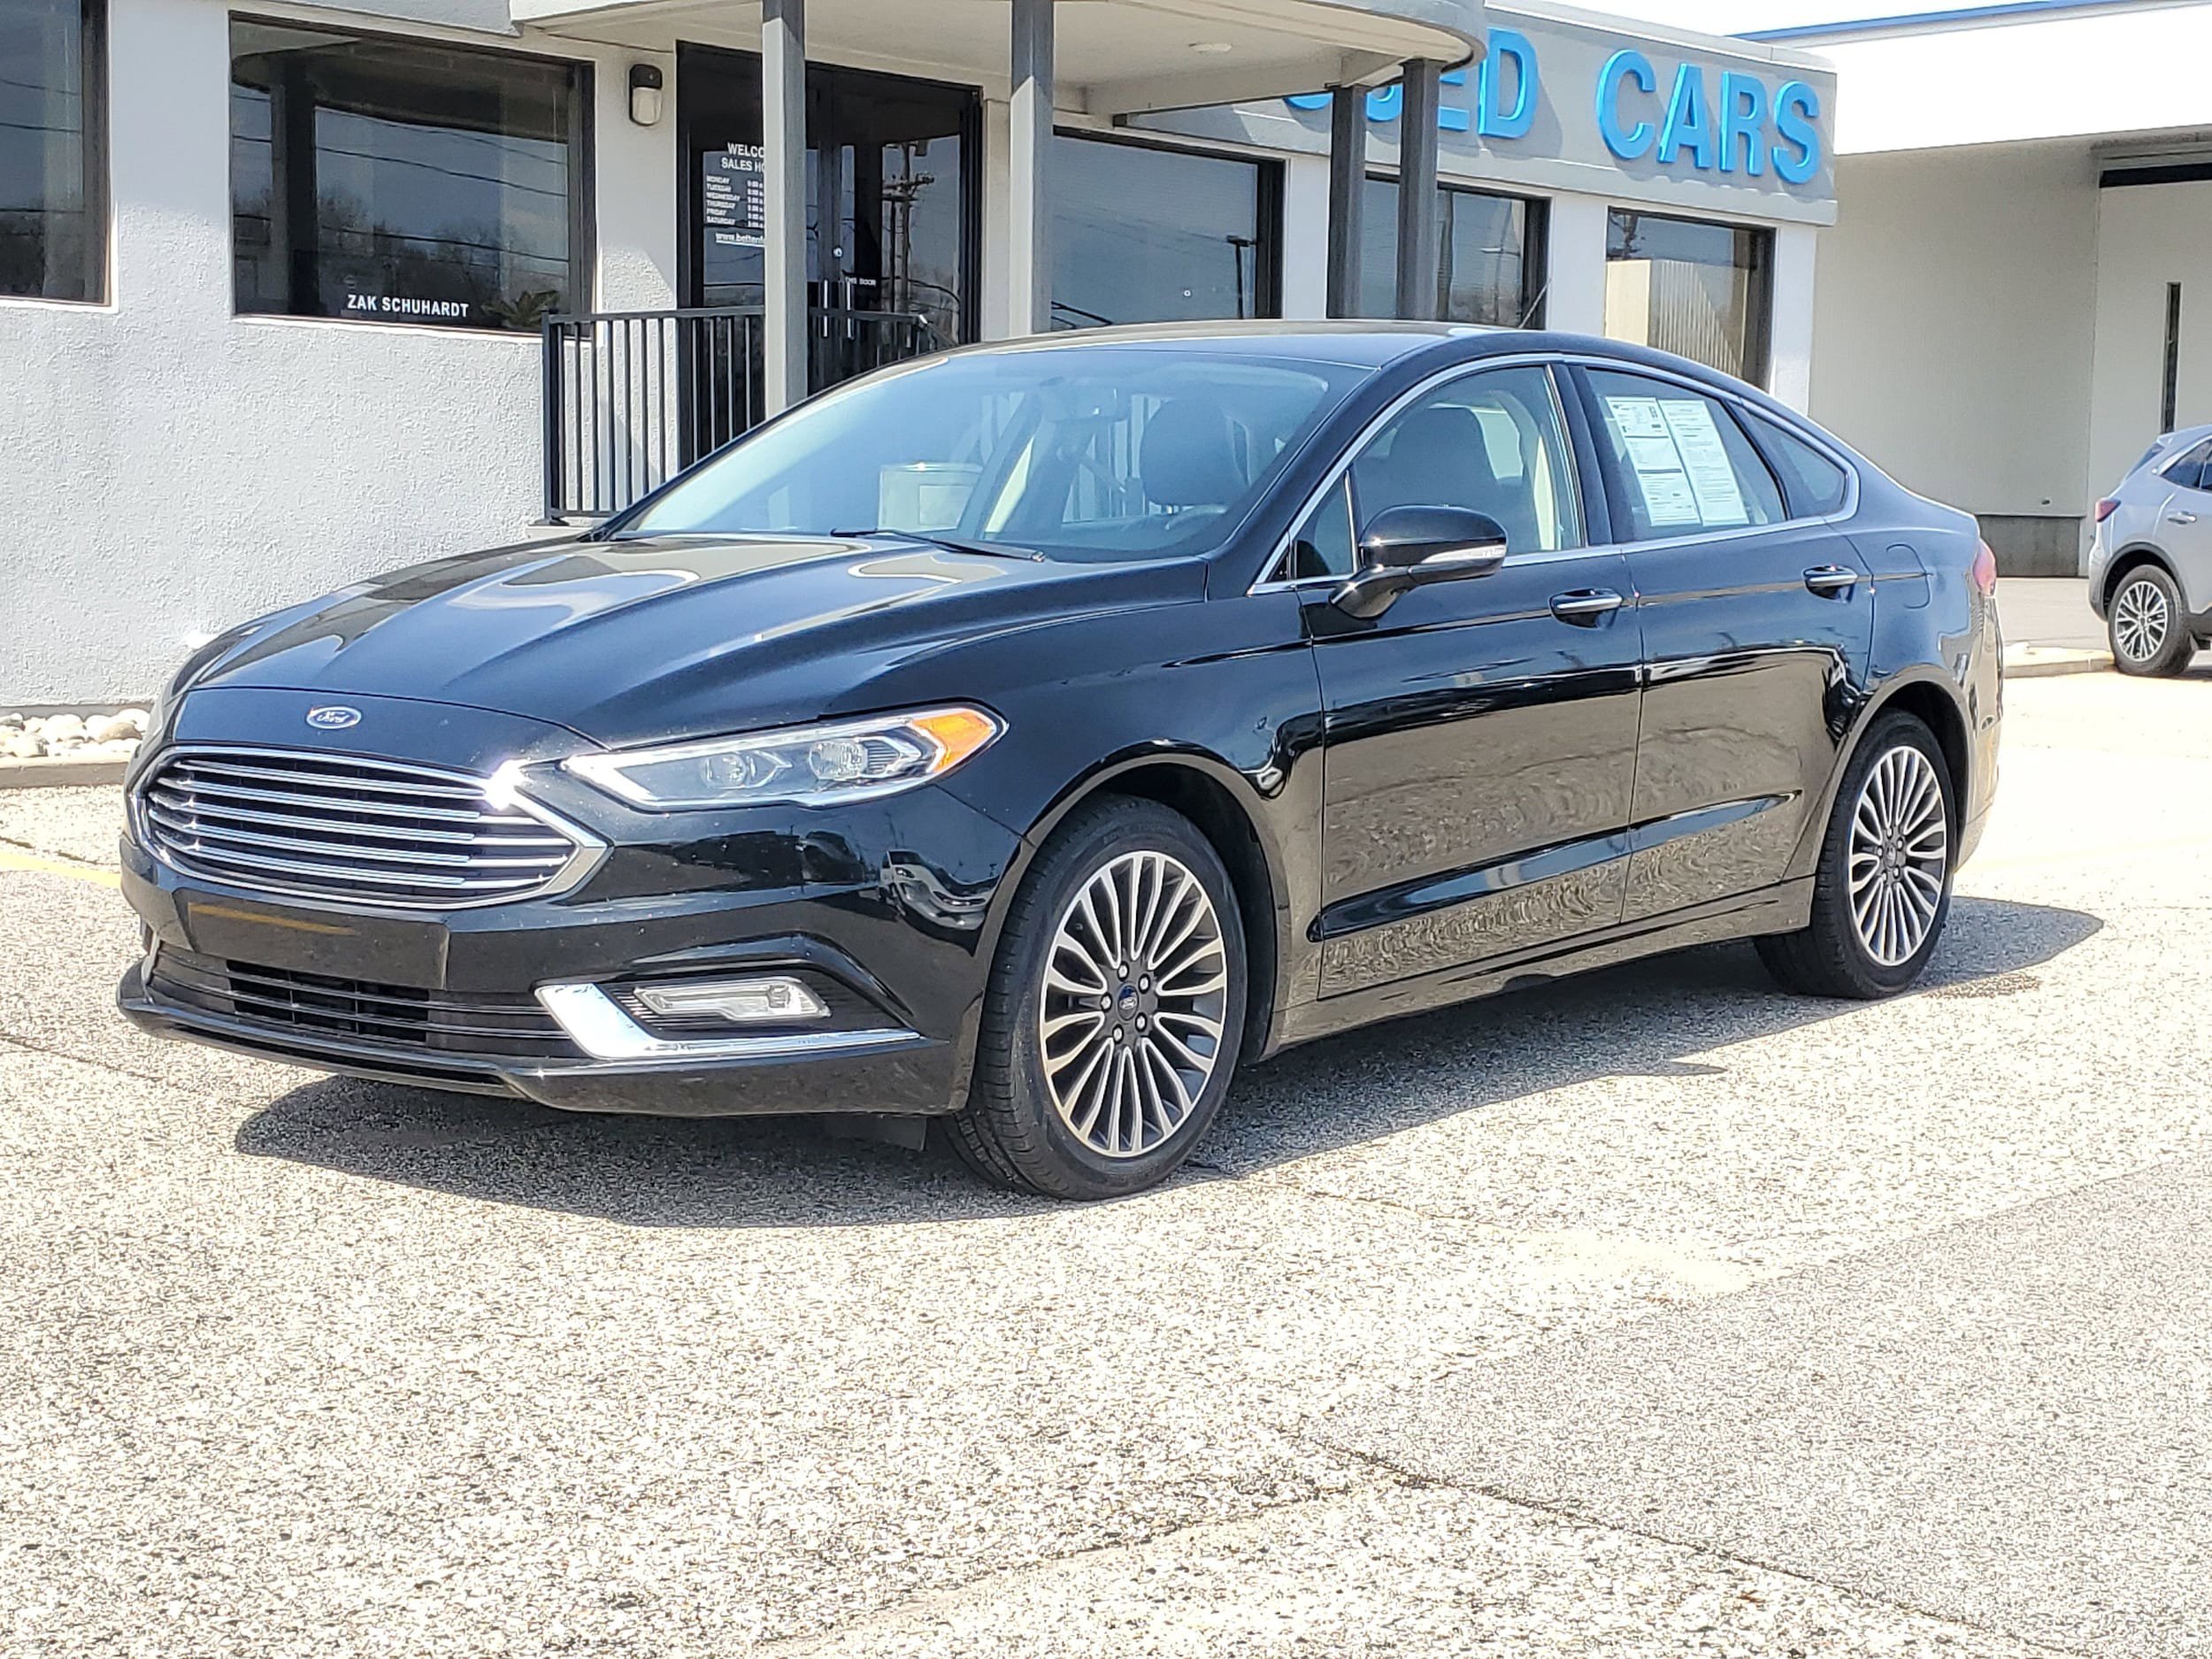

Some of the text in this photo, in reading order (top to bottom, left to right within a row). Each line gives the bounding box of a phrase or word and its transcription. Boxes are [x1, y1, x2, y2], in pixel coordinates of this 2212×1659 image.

[1596, 50, 1821, 184] CARS
[727, 142, 764, 158] WELCO
[721, 157, 752, 171] SALES
[347, 294, 469, 318] ZAK SCHUHARDT
[316, 710, 350, 723] Ford
